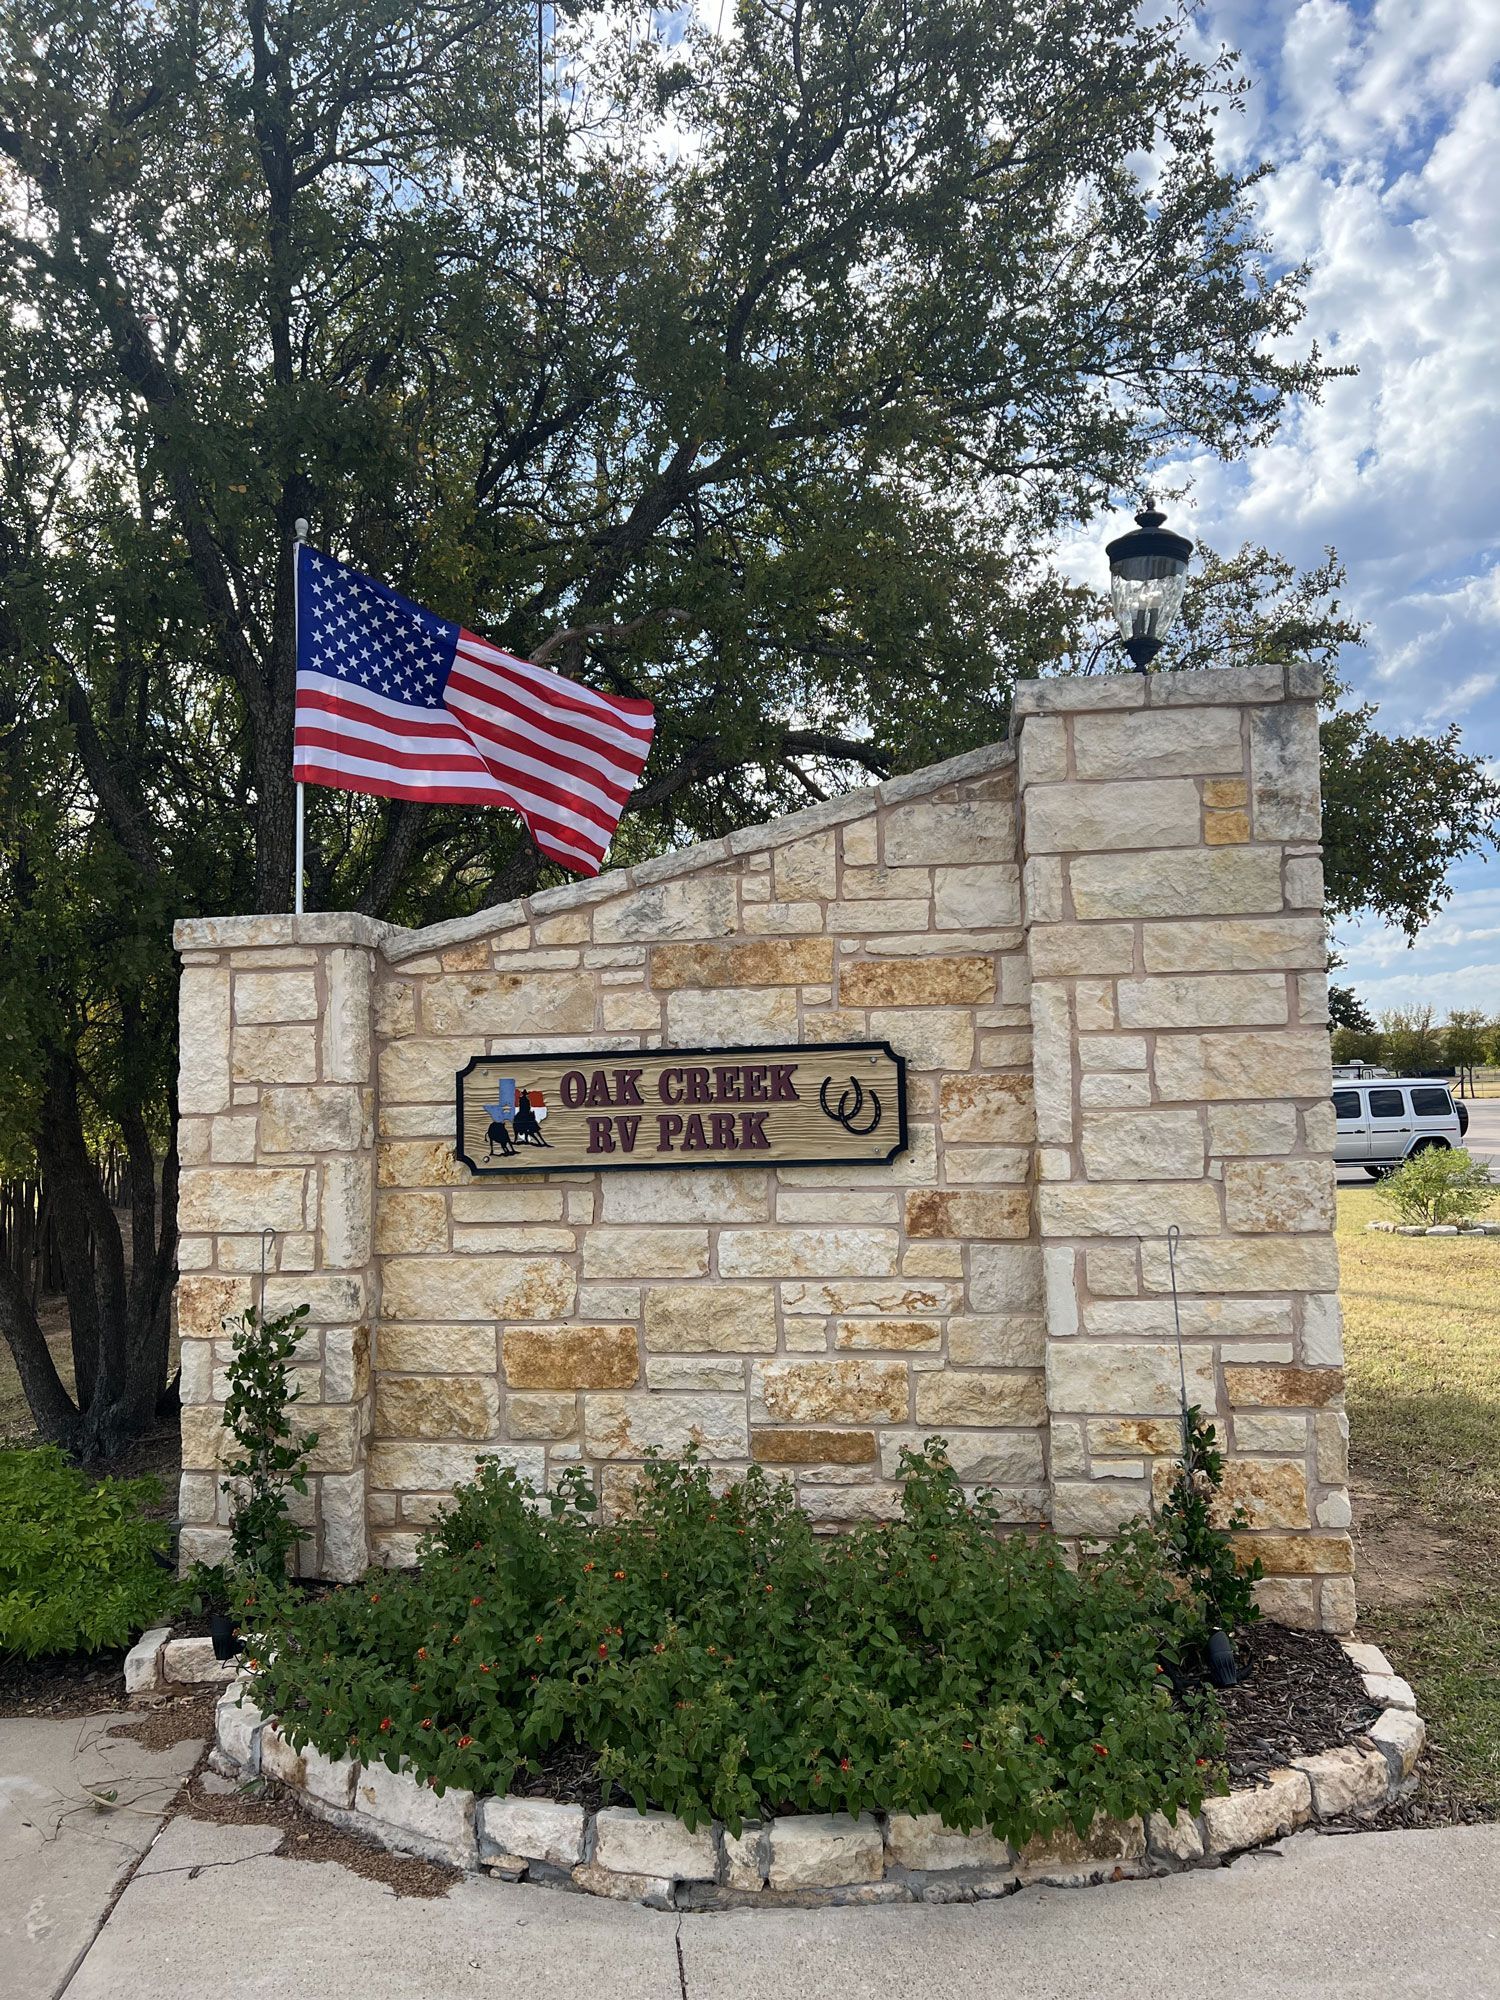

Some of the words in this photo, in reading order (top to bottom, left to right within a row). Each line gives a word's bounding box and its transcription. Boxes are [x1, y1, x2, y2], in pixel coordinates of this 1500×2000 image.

[560, 1068, 645, 1109] OAK
[658, 1064, 799, 1104] CREEK
[586, 1115, 642, 1154] RV
[657, 1112, 771, 1152] PARK
